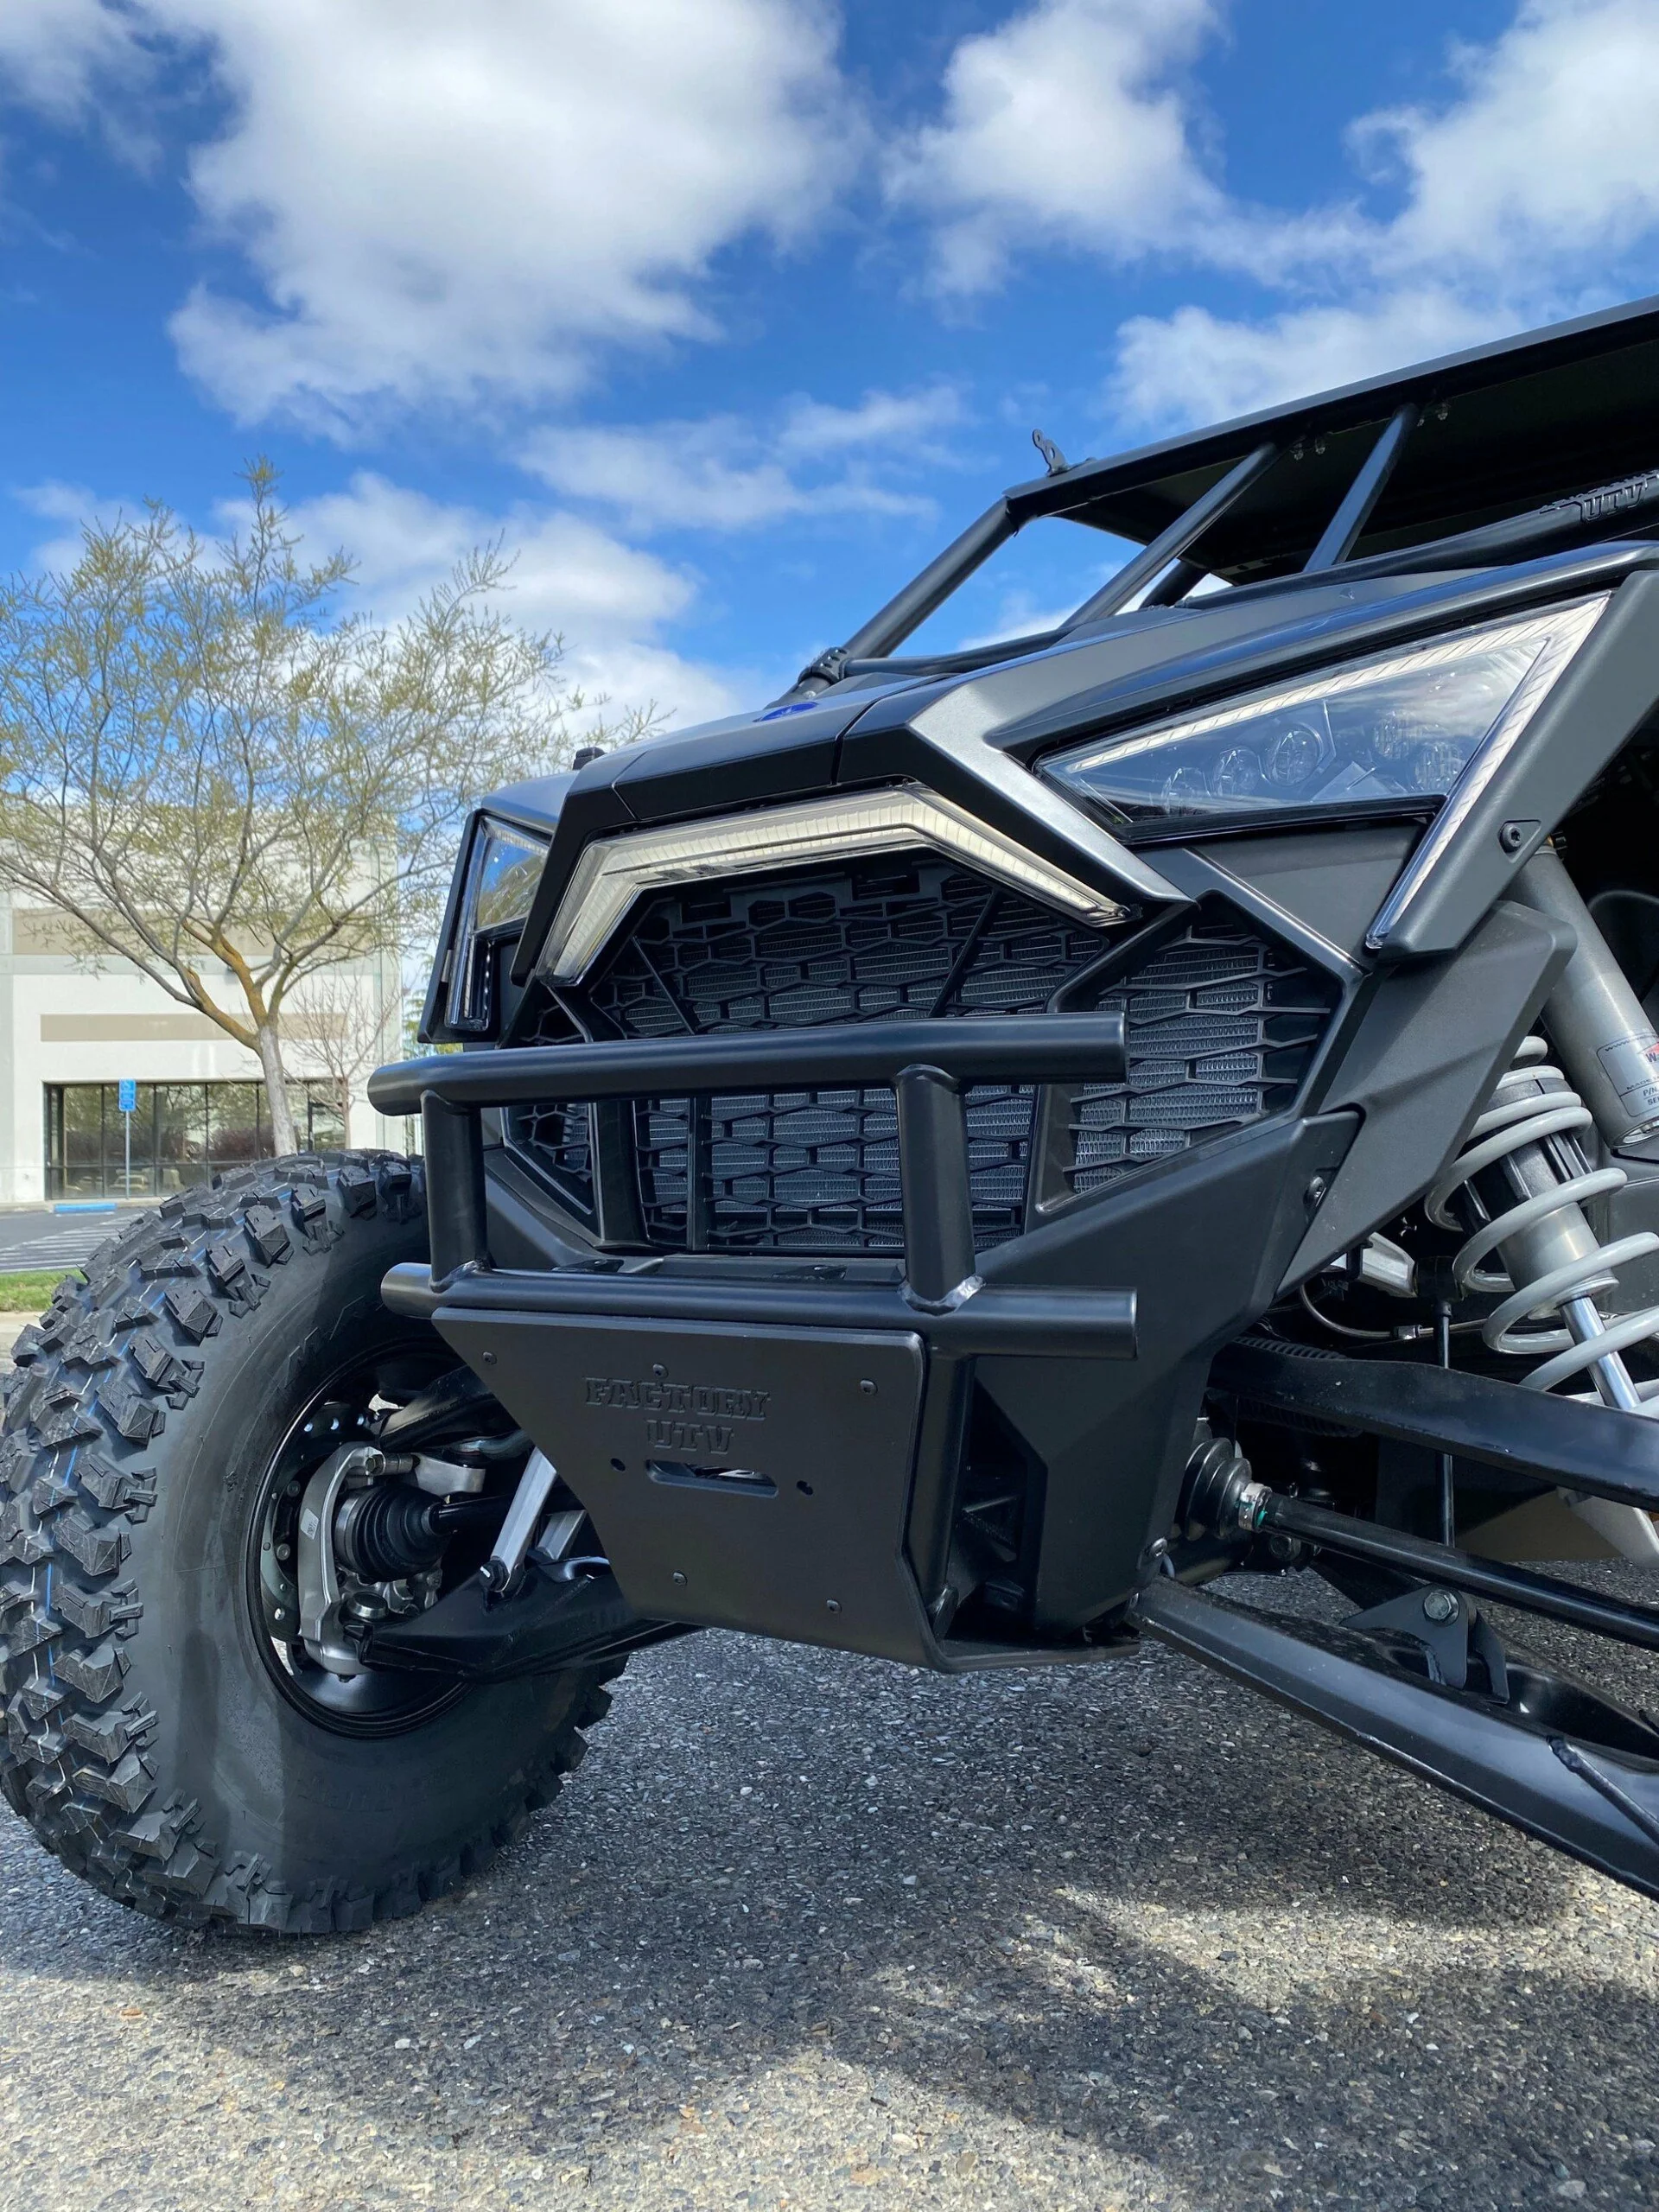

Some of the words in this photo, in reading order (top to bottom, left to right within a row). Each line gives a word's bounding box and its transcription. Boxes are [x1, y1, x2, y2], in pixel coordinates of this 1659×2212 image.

[1580, 481, 1645, 521] UTV
[585, 1376, 771, 1421] FACTORY
[647, 1420, 734, 1455] UTV
